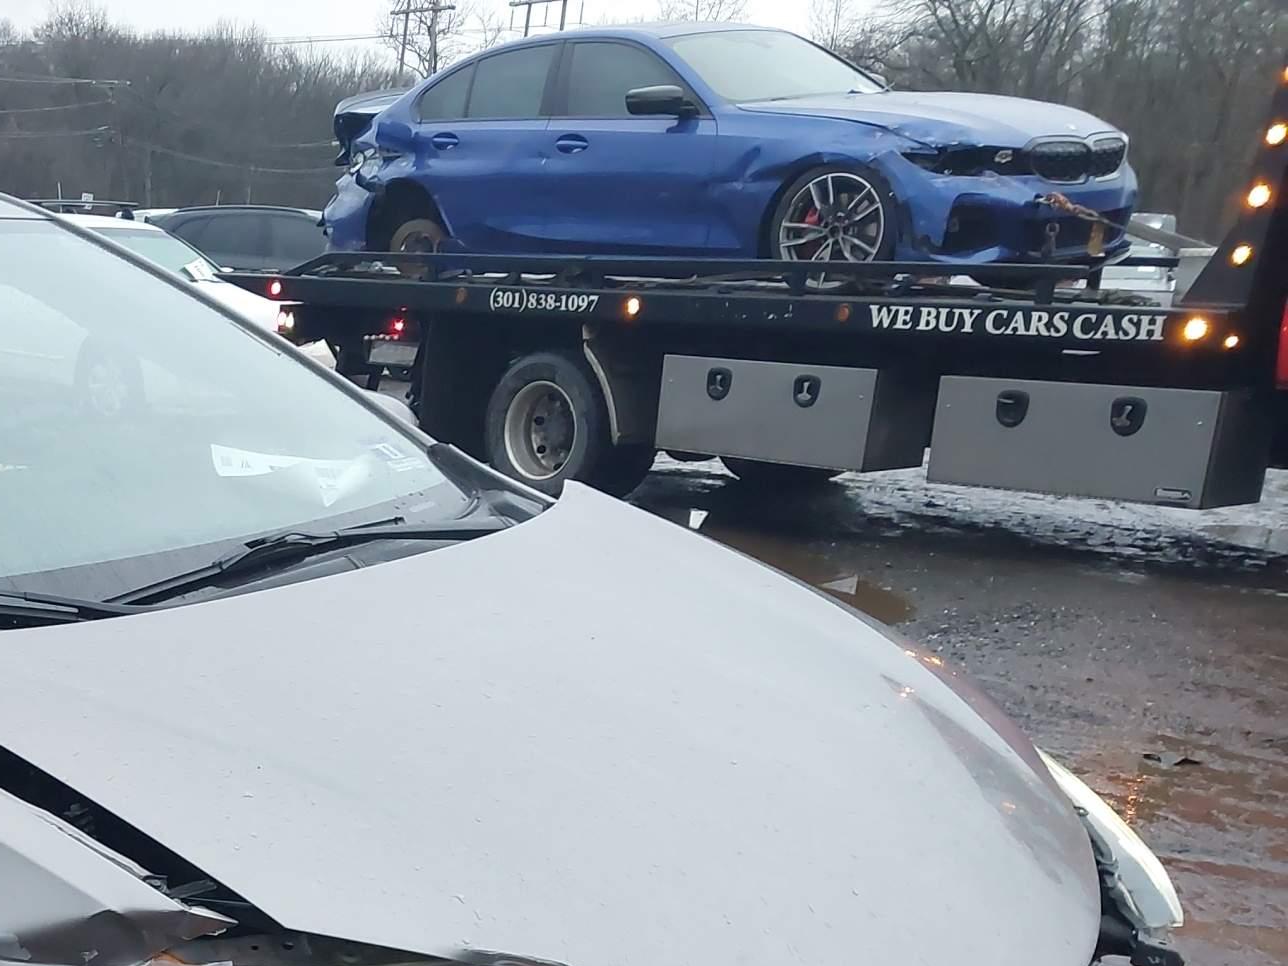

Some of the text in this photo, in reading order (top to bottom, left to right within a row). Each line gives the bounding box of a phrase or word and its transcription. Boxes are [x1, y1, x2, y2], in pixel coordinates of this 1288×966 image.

[869, 304, 1168, 341] WE BUY CARS CASH
